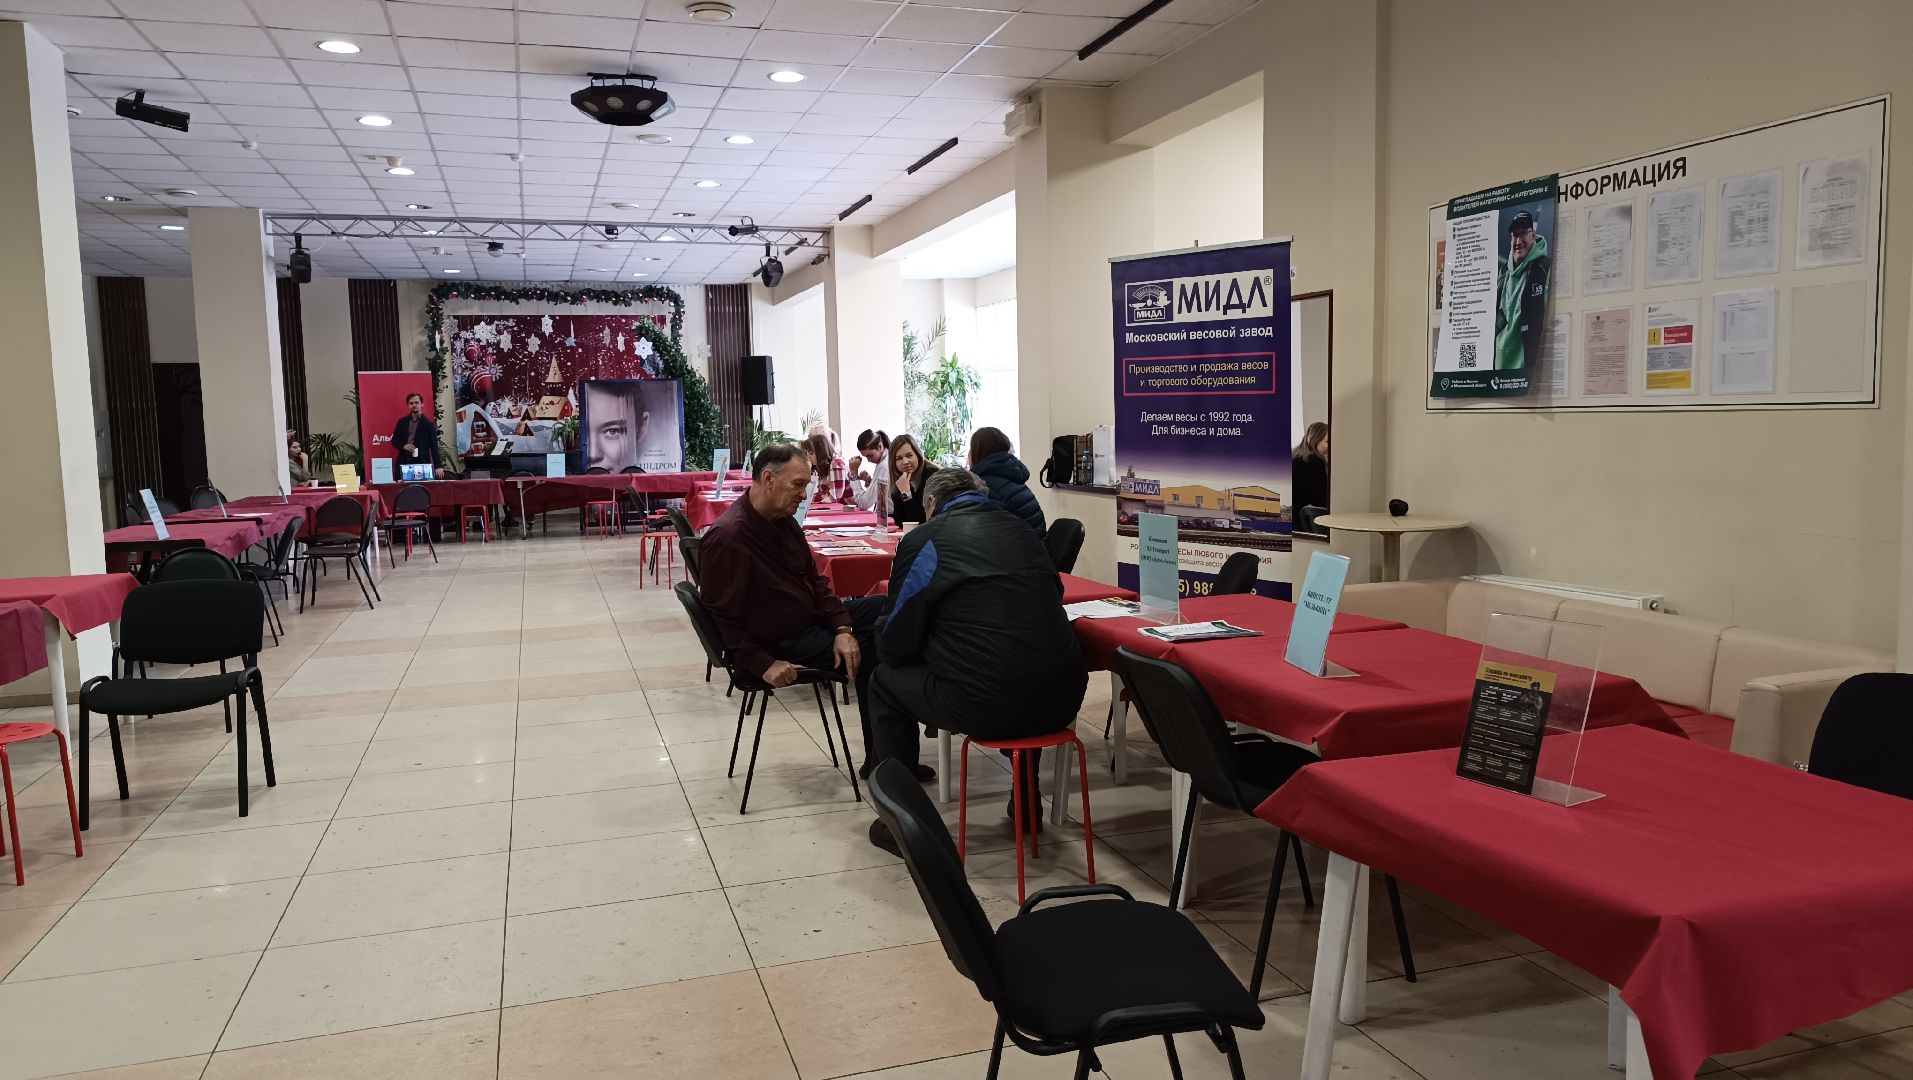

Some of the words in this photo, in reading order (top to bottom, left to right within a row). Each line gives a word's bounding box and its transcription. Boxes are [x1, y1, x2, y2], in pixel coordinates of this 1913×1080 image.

[1558, 157, 1687, 203] НФОРМАЦИЯ
[1136, 310, 1163, 319] МИДЛ
[1126, 329, 1186, 344] Московский
[1189, 326, 1236, 340] весовой
[1239, 326, 1273, 337] завод
[1129, 364, 1188, 376] Производство
[1190, 364, 1197, 372] и
[1199, 362, 1239, 374] продажа
[1241, 361, 1269, 370] весов
[1140, 379, 1145, 387] и
[1148, 378, 1188, 388] торгового
[1190, 375, 1256, 388] оборудования
[1140, 412, 1174, 423] Делаем
[1175, 413, 1198, 422] весы
[1200, 414, 1206, 422] с
[1208, 412, 1230, 422] 1992
[1232, 413, 1255, 423] года.
[1151, 425, 1168, 436] Для
[1170, 425, 1207, 436] бизнеса
[1208, 427, 1215, 436] и
[1216, 428, 1244, 437] дома.
[1135, 483, 1159, 494] МИДЛ
[1177, 547, 1193, 556] ЕСЫ
[1194, 549, 1224, 560] ЛЮБОГО
